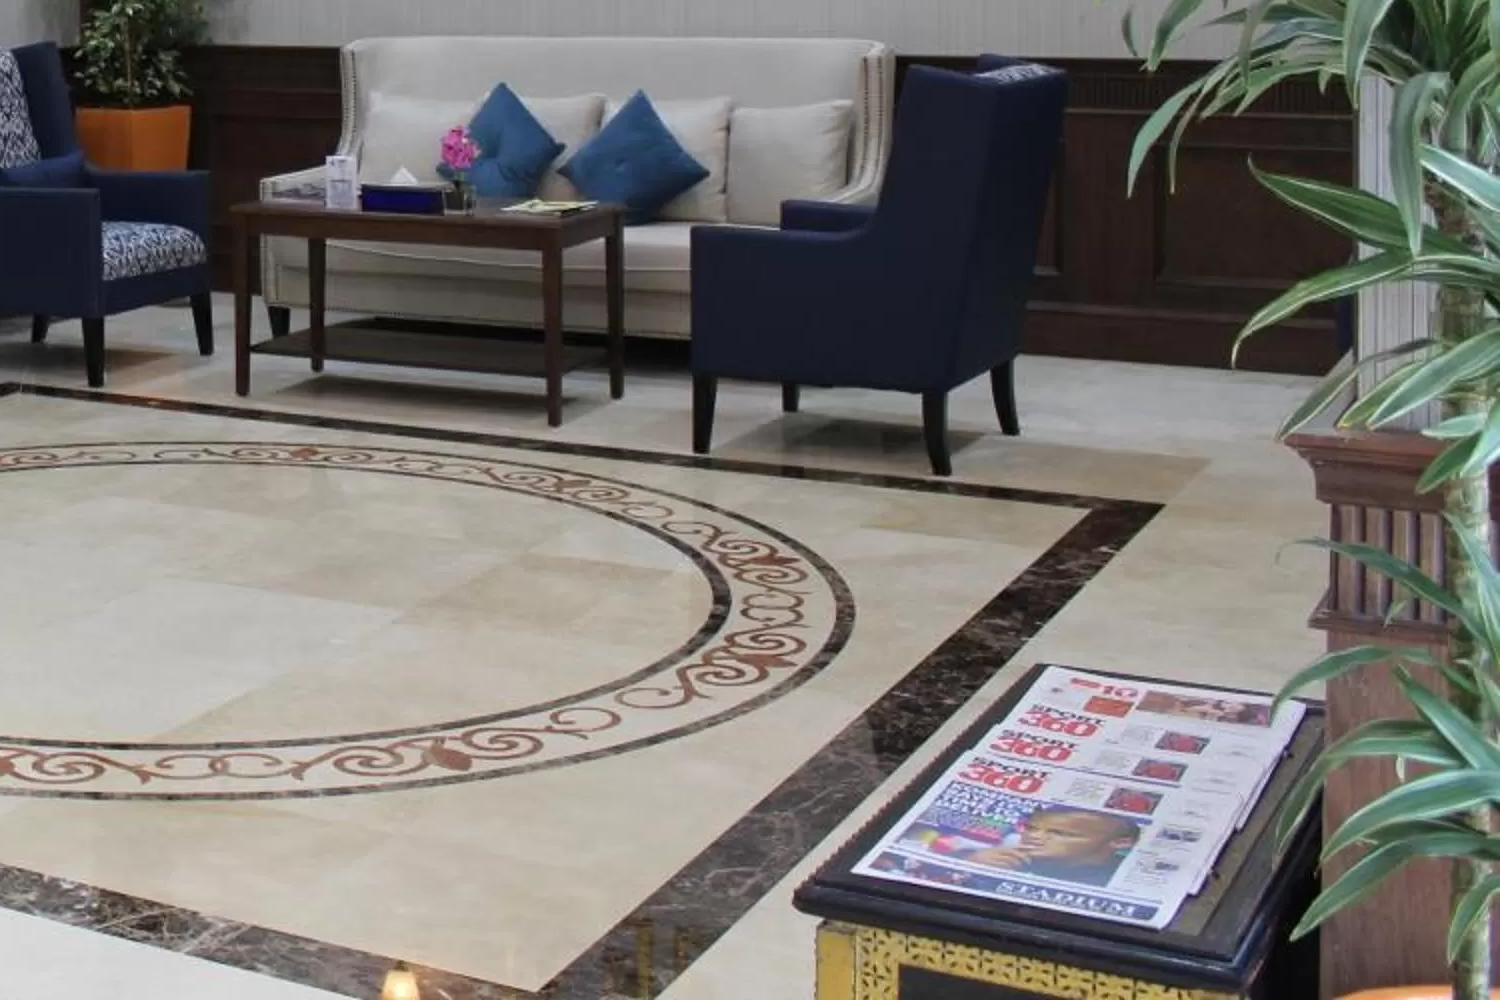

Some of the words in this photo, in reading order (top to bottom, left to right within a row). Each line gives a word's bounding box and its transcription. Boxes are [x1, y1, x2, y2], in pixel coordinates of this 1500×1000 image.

[1018, 711, 1099, 737] 360
[1031, 704, 1107, 725] SPORT
[990, 736, 1072, 762] 360
[1002, 729, 1077, 749] SPORT
[957, 763, 1045, 793] 360
[974, 756, 1049, 778] SPORT
[998, 881, 1136, 917] STADIUM
